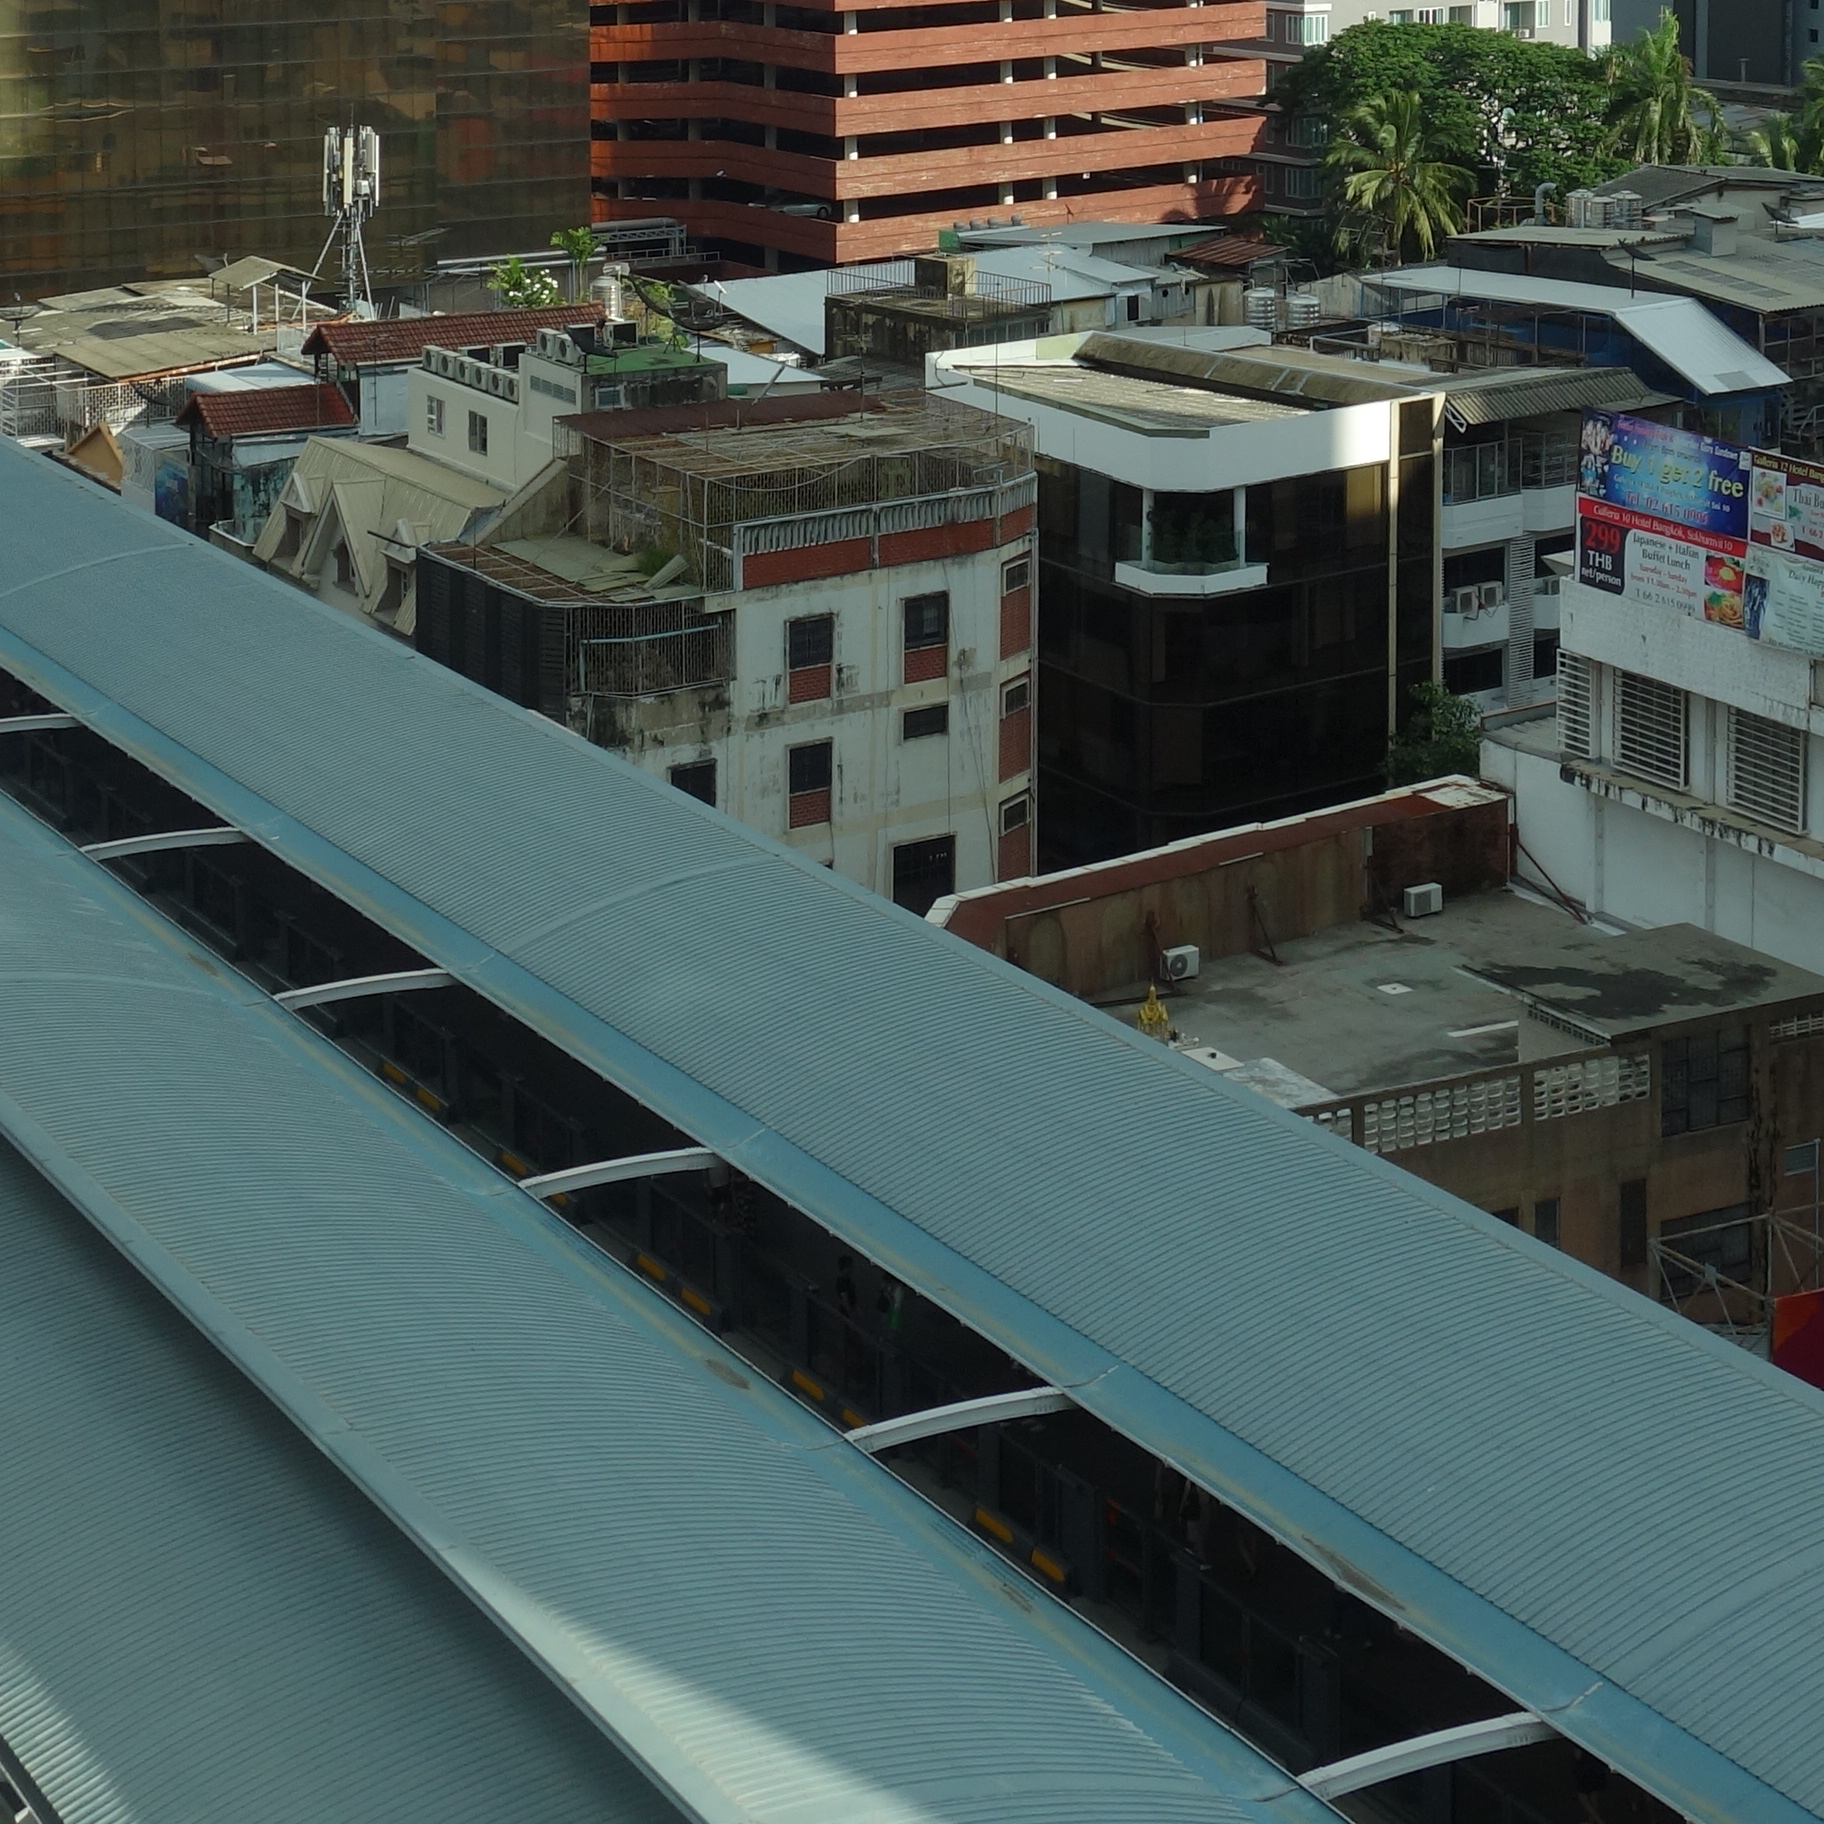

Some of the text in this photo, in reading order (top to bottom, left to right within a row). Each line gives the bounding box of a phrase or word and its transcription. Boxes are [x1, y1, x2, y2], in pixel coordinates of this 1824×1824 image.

[1610, 444, 1643, 474] Buy
[1660, 463, 1690, 486] get
[1692, 468, 1704, 488] 2
[1708, 470, 1744, 498] free
[1780, 461, 1789, 472] 12
[1789, 463, 1808, 476] Hotel
[1793, 488, 1815, 505] Thai
[1622, 511, 1631, 522] 10
[1631, 512, 1652, 528] Hotel
[1653, 517, 1686, 540] Bangkok,
[1585, 521, 1621, 553] 299
[1633, 532, 1666, 551] Japanese
[1675, 542, 1699, 560] Italian
[1588, 550, 1613, 571] THB
[1642, 548, 1690, 570] Buffet Lunch
[1642, 591, 1653, 602] 66
